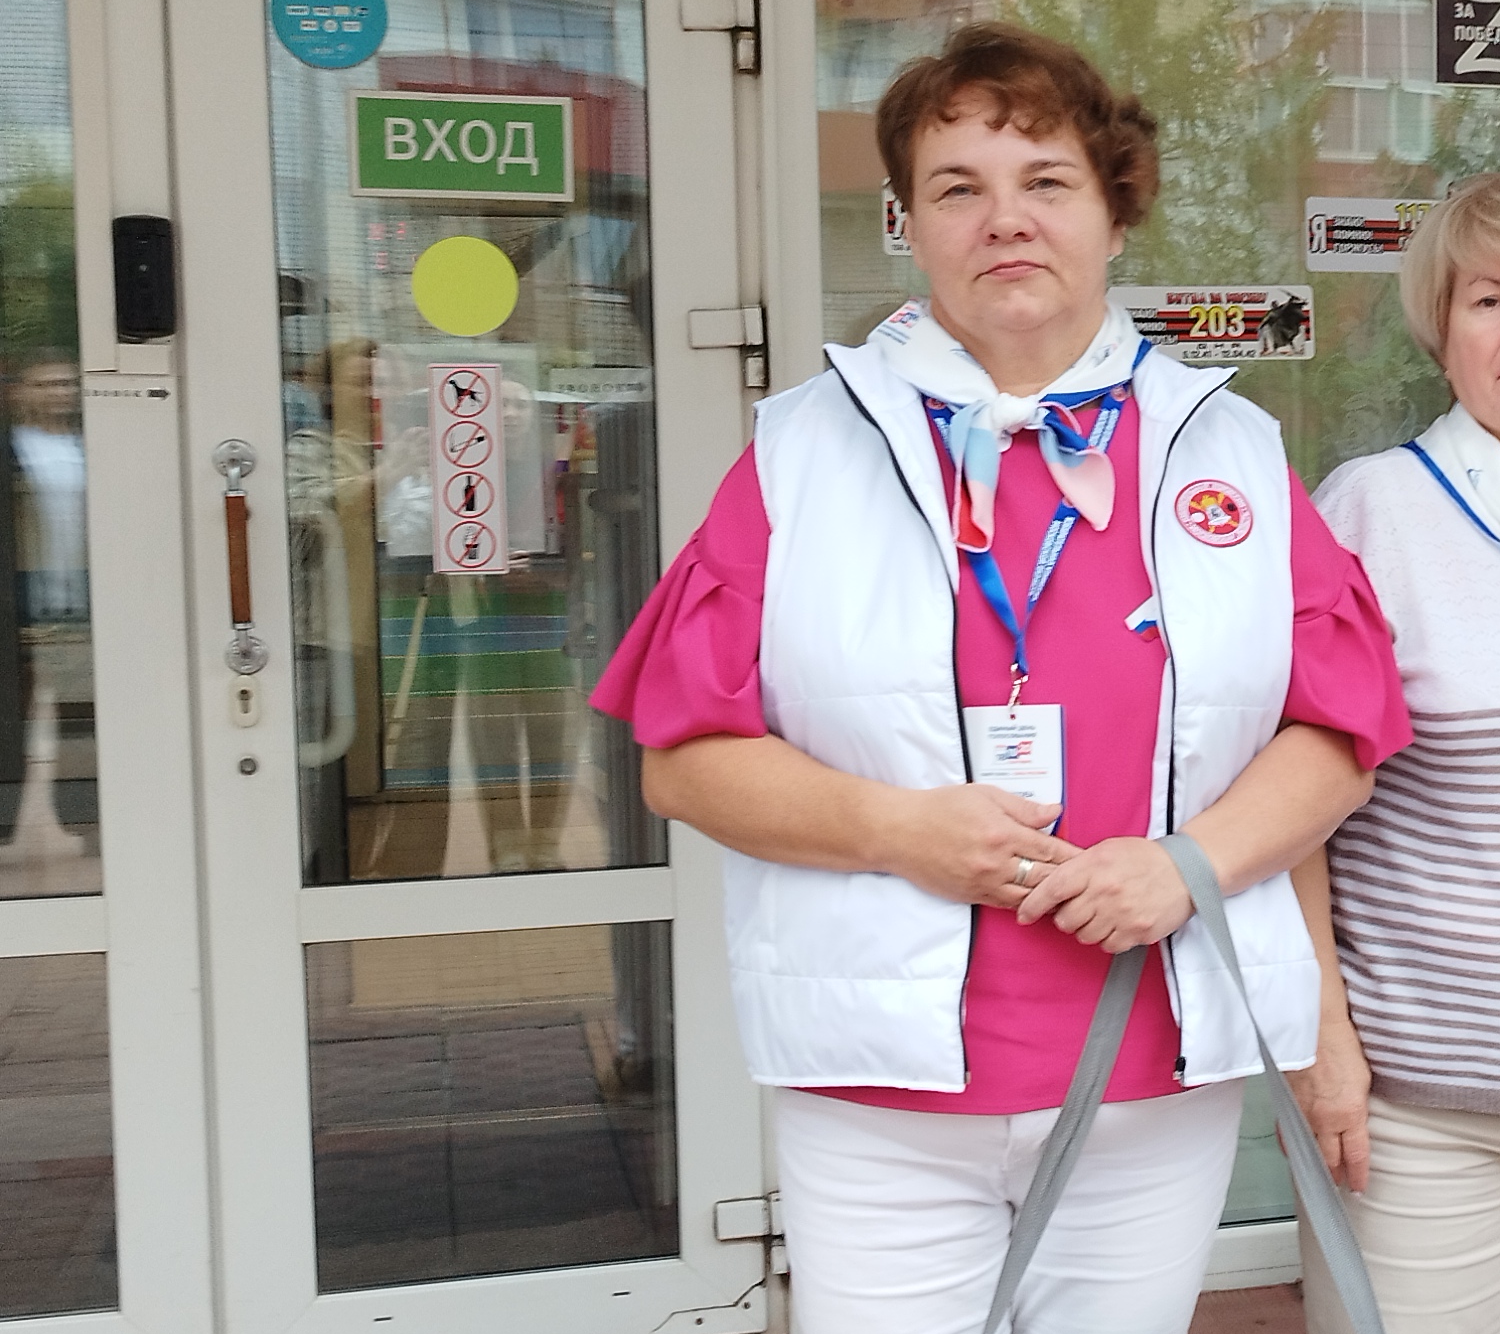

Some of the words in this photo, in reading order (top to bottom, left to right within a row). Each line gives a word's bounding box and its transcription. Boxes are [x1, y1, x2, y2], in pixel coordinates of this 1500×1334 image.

[1454, 2, 1475, 19] ЗА
[384, 116, 539, 176] ВХОД
[1310, 213, 1327, 253] Я
[1189, 305, 1245, 338] 203
